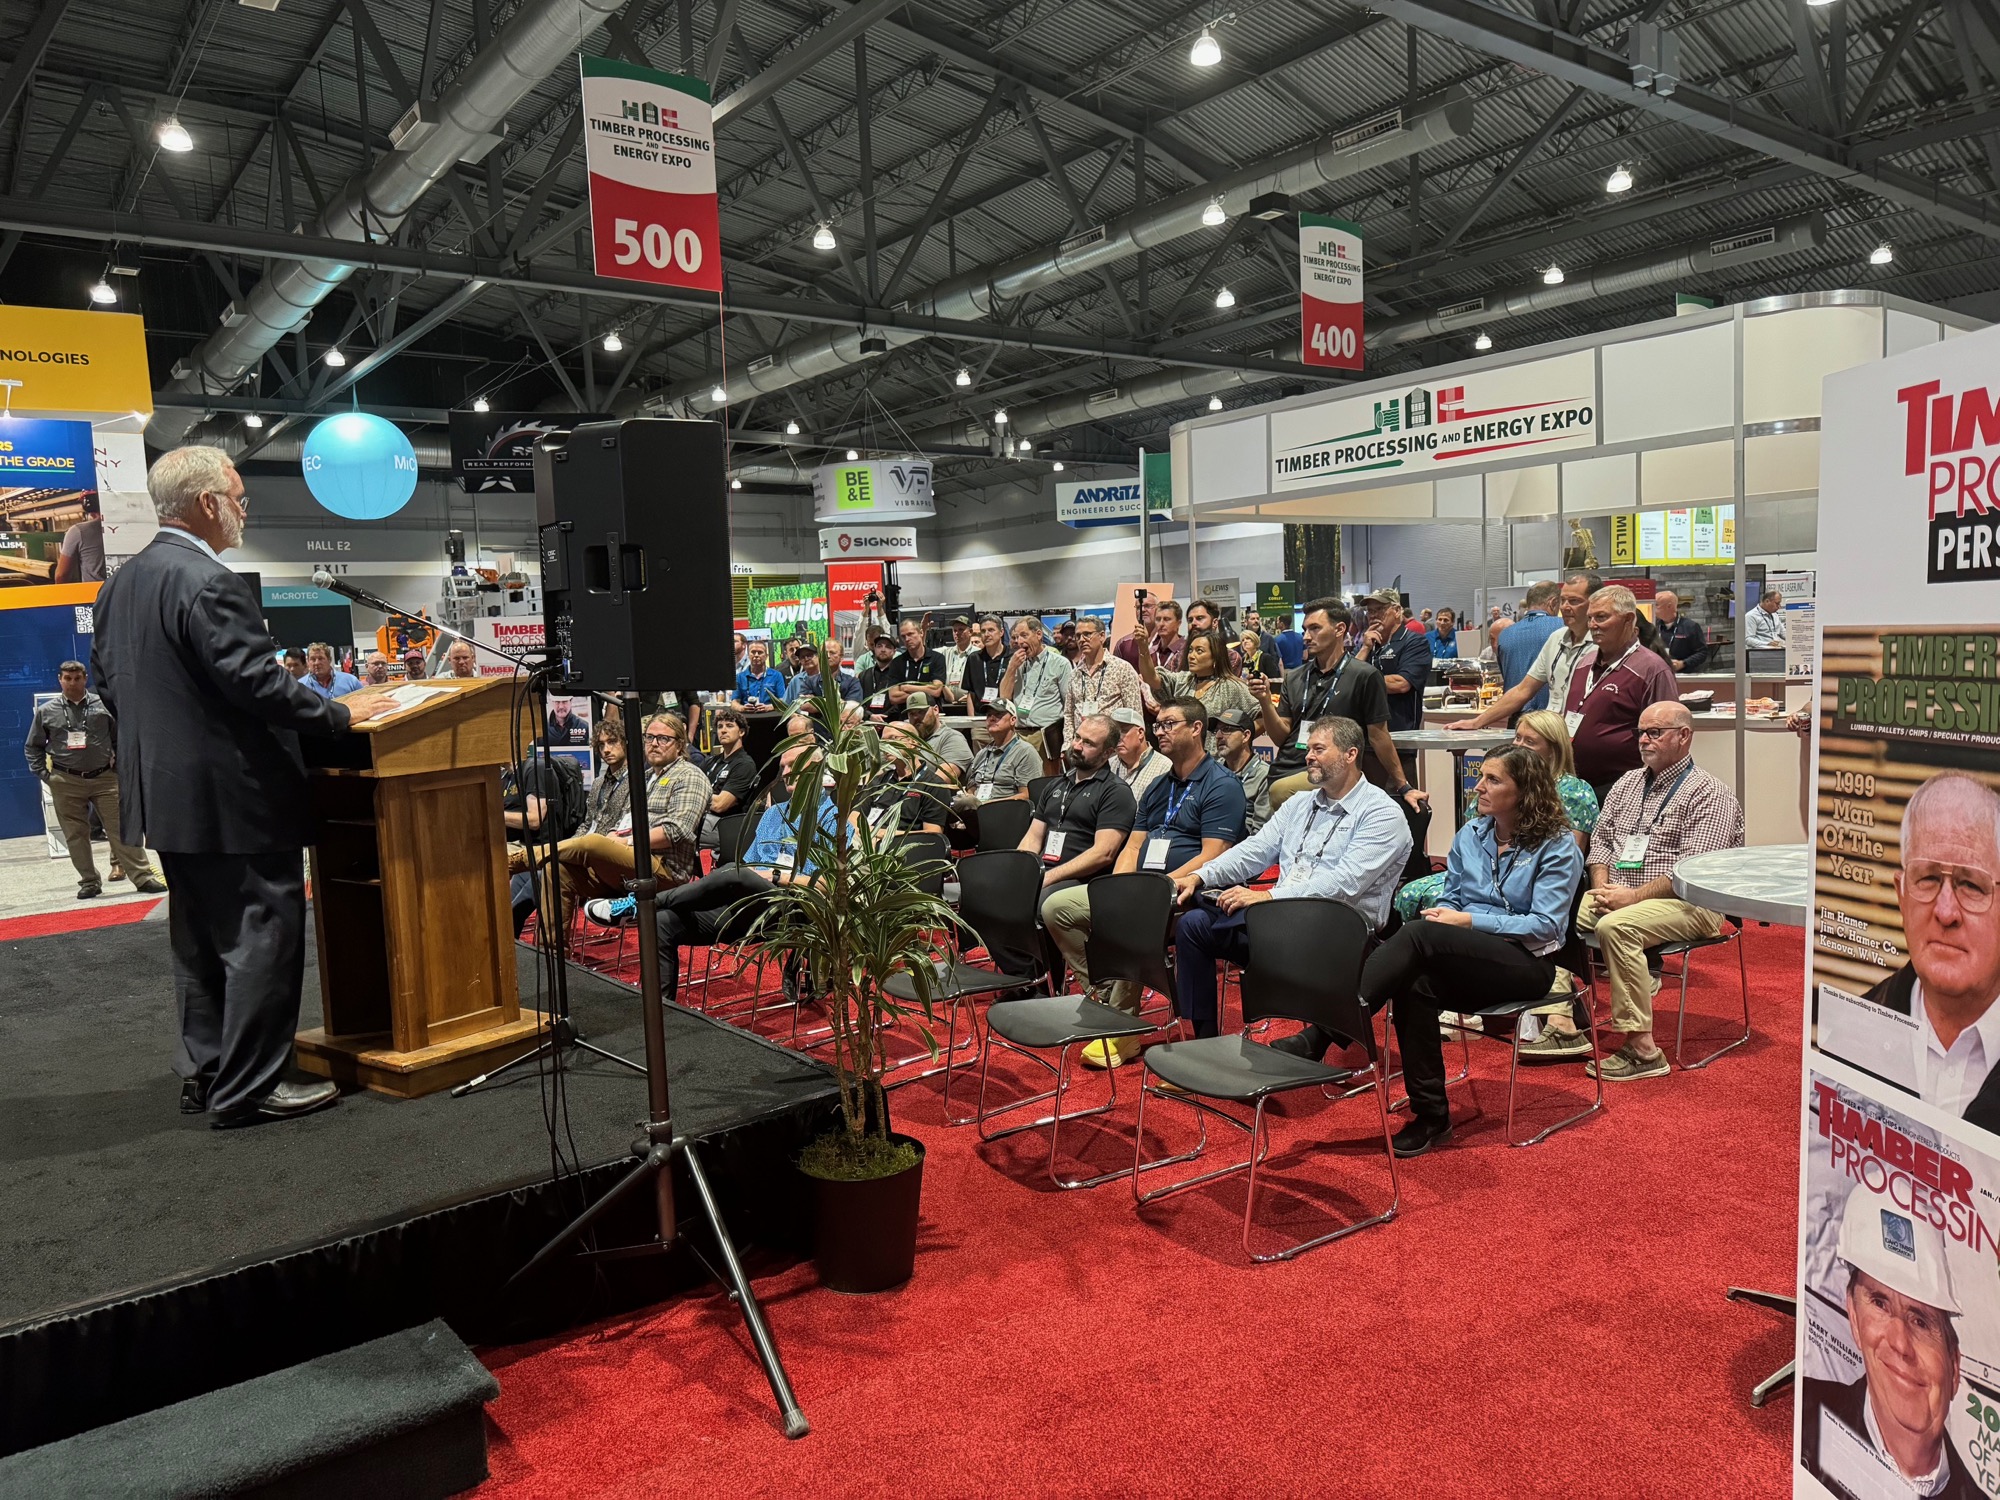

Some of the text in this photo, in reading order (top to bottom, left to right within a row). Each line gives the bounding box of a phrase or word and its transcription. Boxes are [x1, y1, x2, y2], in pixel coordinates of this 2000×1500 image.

[589, 118, 710, 151] TIMBER PROCESSING
[646, 141, 659, 149] AND
[613, 144, 692, 169] ENERGY EXPO
[614, 217, 703, 274] 500
[1303, 255, 1361, 273] TIMBER PROCESSING
[1313, 272, 1352, 286] ENERGY EXPO
[1311, 323, 1356, 359] 400
[1275, 406, 1593, 474] TIMBER PROCESSING AND ENERGY EXPO
[26, 457, 75, 468] GRADE
[845, 470, 869, 486] BE
[847, 486, 870, 502] &E
[1061, 505, 1116, 516] ENGINEERED
[306, 540, 351, 551] HALL E2
[853, 537, 912, 547] SIGNODE
[1616, 516, 1627, 557] MILLS
[832, 581, 878, 591] novilco
[492, 623, 545, 638] TIMBER
[502, 646, 526, 654] PERSON
[1879, 635, 1997, 679] TIMBER
[479, 665, 514, 675] TIMBER
[1850, 723, 1874, 733] LUMBER
[1878, 726, 1905, 737] PALLETS
[1908, 729, 1929, 738] CHIPS
[1932, 731, 1970, 742] SPECIALTY
[1835, 770, 1876, 798] 1999
[1832, 798, 1875, 828] Man
[1823, 824, 1884, 859] Of The
[1830, 854, 1874, 885] Year
[1820, 906, 1869, 931] Jim Hamer
[1819, 934, 1887, 967] Kenova, W. Va.
[1820, 921, 1900, 956] Jim C. Hamer Co.
[1823, 986, 1839, 998] Thanks
[1838, 992, 1846, 1001] for
[1845, 997, 1871, 1012] subscribing
[1877, 1008, 1894, 1020] Timber
[1893, 1014, 1920, 1031] Processing
[1838, 1095, 1857, 1110] LUMBER
[1881, 1117, 1898, 1130] CHIPS
[1902, 1126, 1933, 1147] ENGINEERED
[1933, 1143, 1961, 1162] PRODUCTS
[1814, 1080, 1976, 1210] TIMBER
[1808, 1318, 1863, 1365] LARRY WILLIAMS
[1808, 1327, 1858, 1369] IDAHO TIMBER CORP.
[1965, 1392, 2000, 1433] 20
[1968, 1439, 1991, 1466] OF
